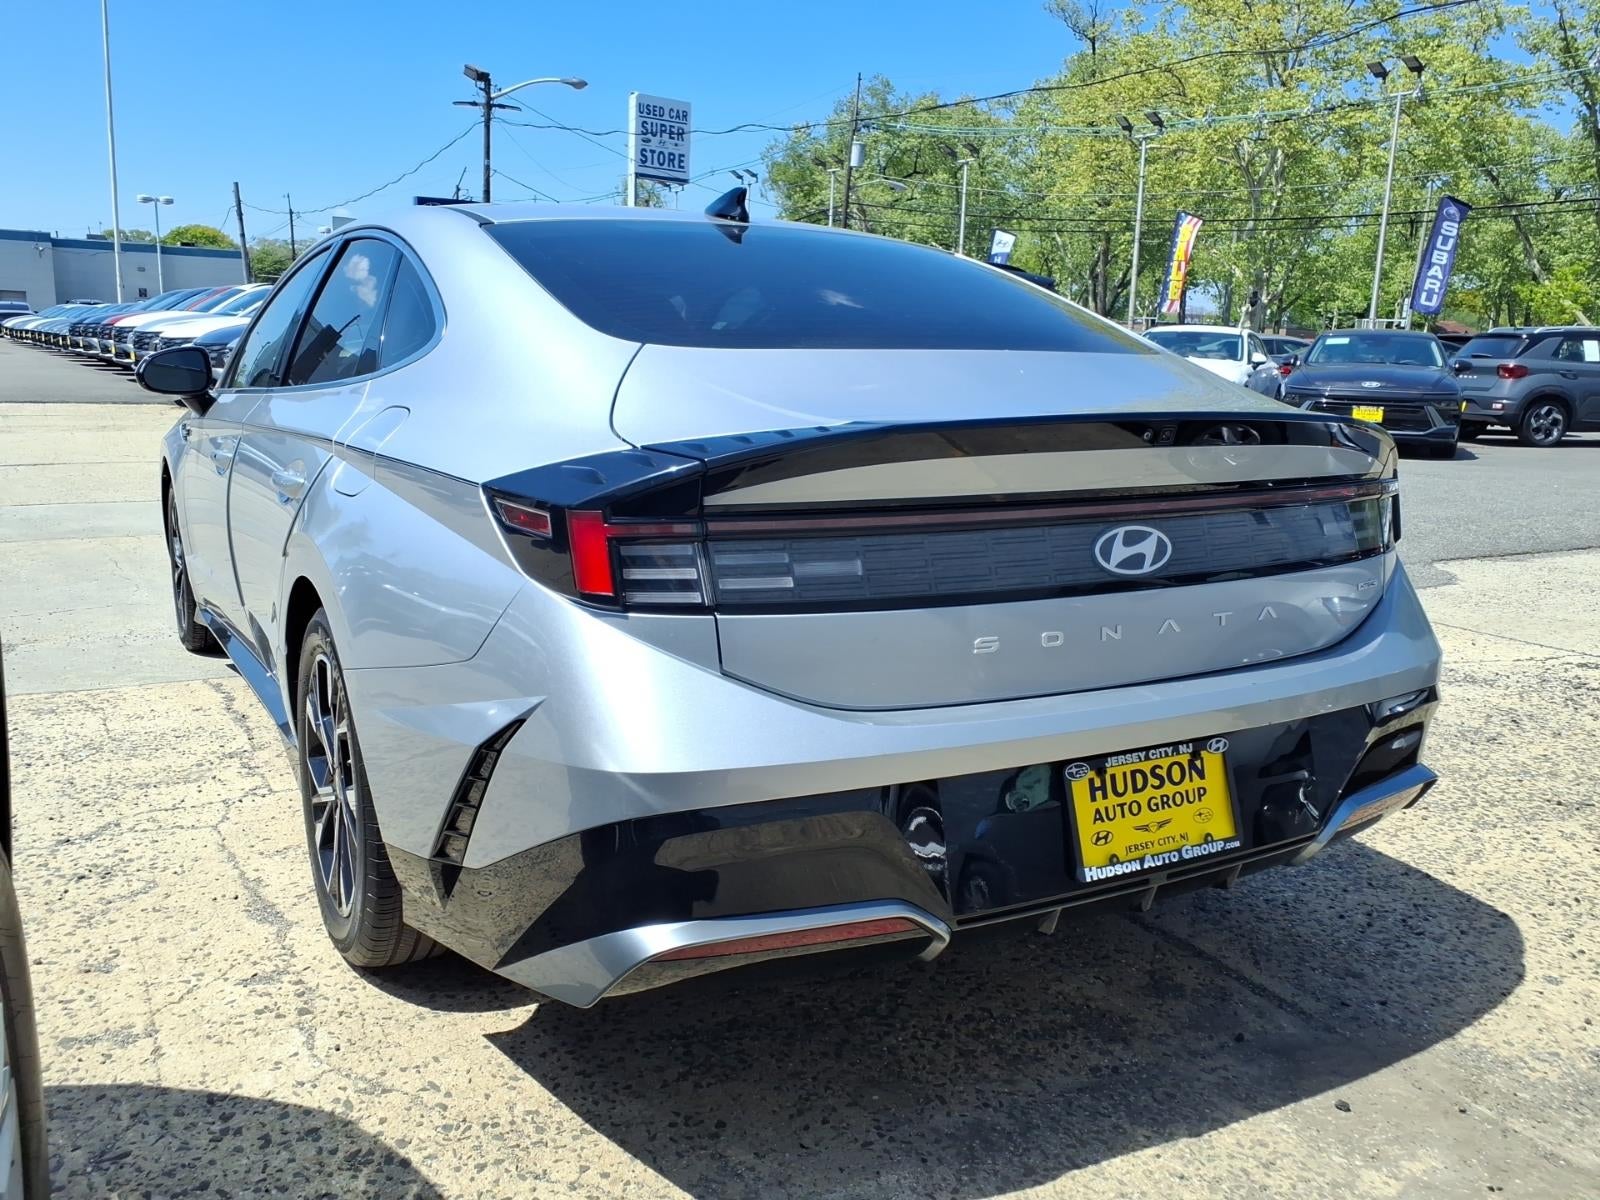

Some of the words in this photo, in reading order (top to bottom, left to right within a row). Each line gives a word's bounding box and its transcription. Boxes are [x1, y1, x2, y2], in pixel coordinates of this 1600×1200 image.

[638, 102, 665, 117] USED
[668, 107, 689, 122] CAR
[640, 120, 685, 142] SUPER
[639, 147, 686, 169] STORE
[1420, 221, 1459, 307] SUBARU
[973, 606, 1278, 655] SONATA
[1104, 751, 1146, 768] JERSEY
[1178, 743, 1193, 753] NJ
[1089, 757, 1206, 802] HUDSON
[1093, 799, 1142, 825] AUTO
[1147, 786, 1207, 813] GROUP
[1125, 838, 1155, 856] JERSEY
[1180, 831, 1189, 842] NJ
[1084, 862, 1141, 882] HUDSON
[1143, 853, 1178, 869] AUTO
